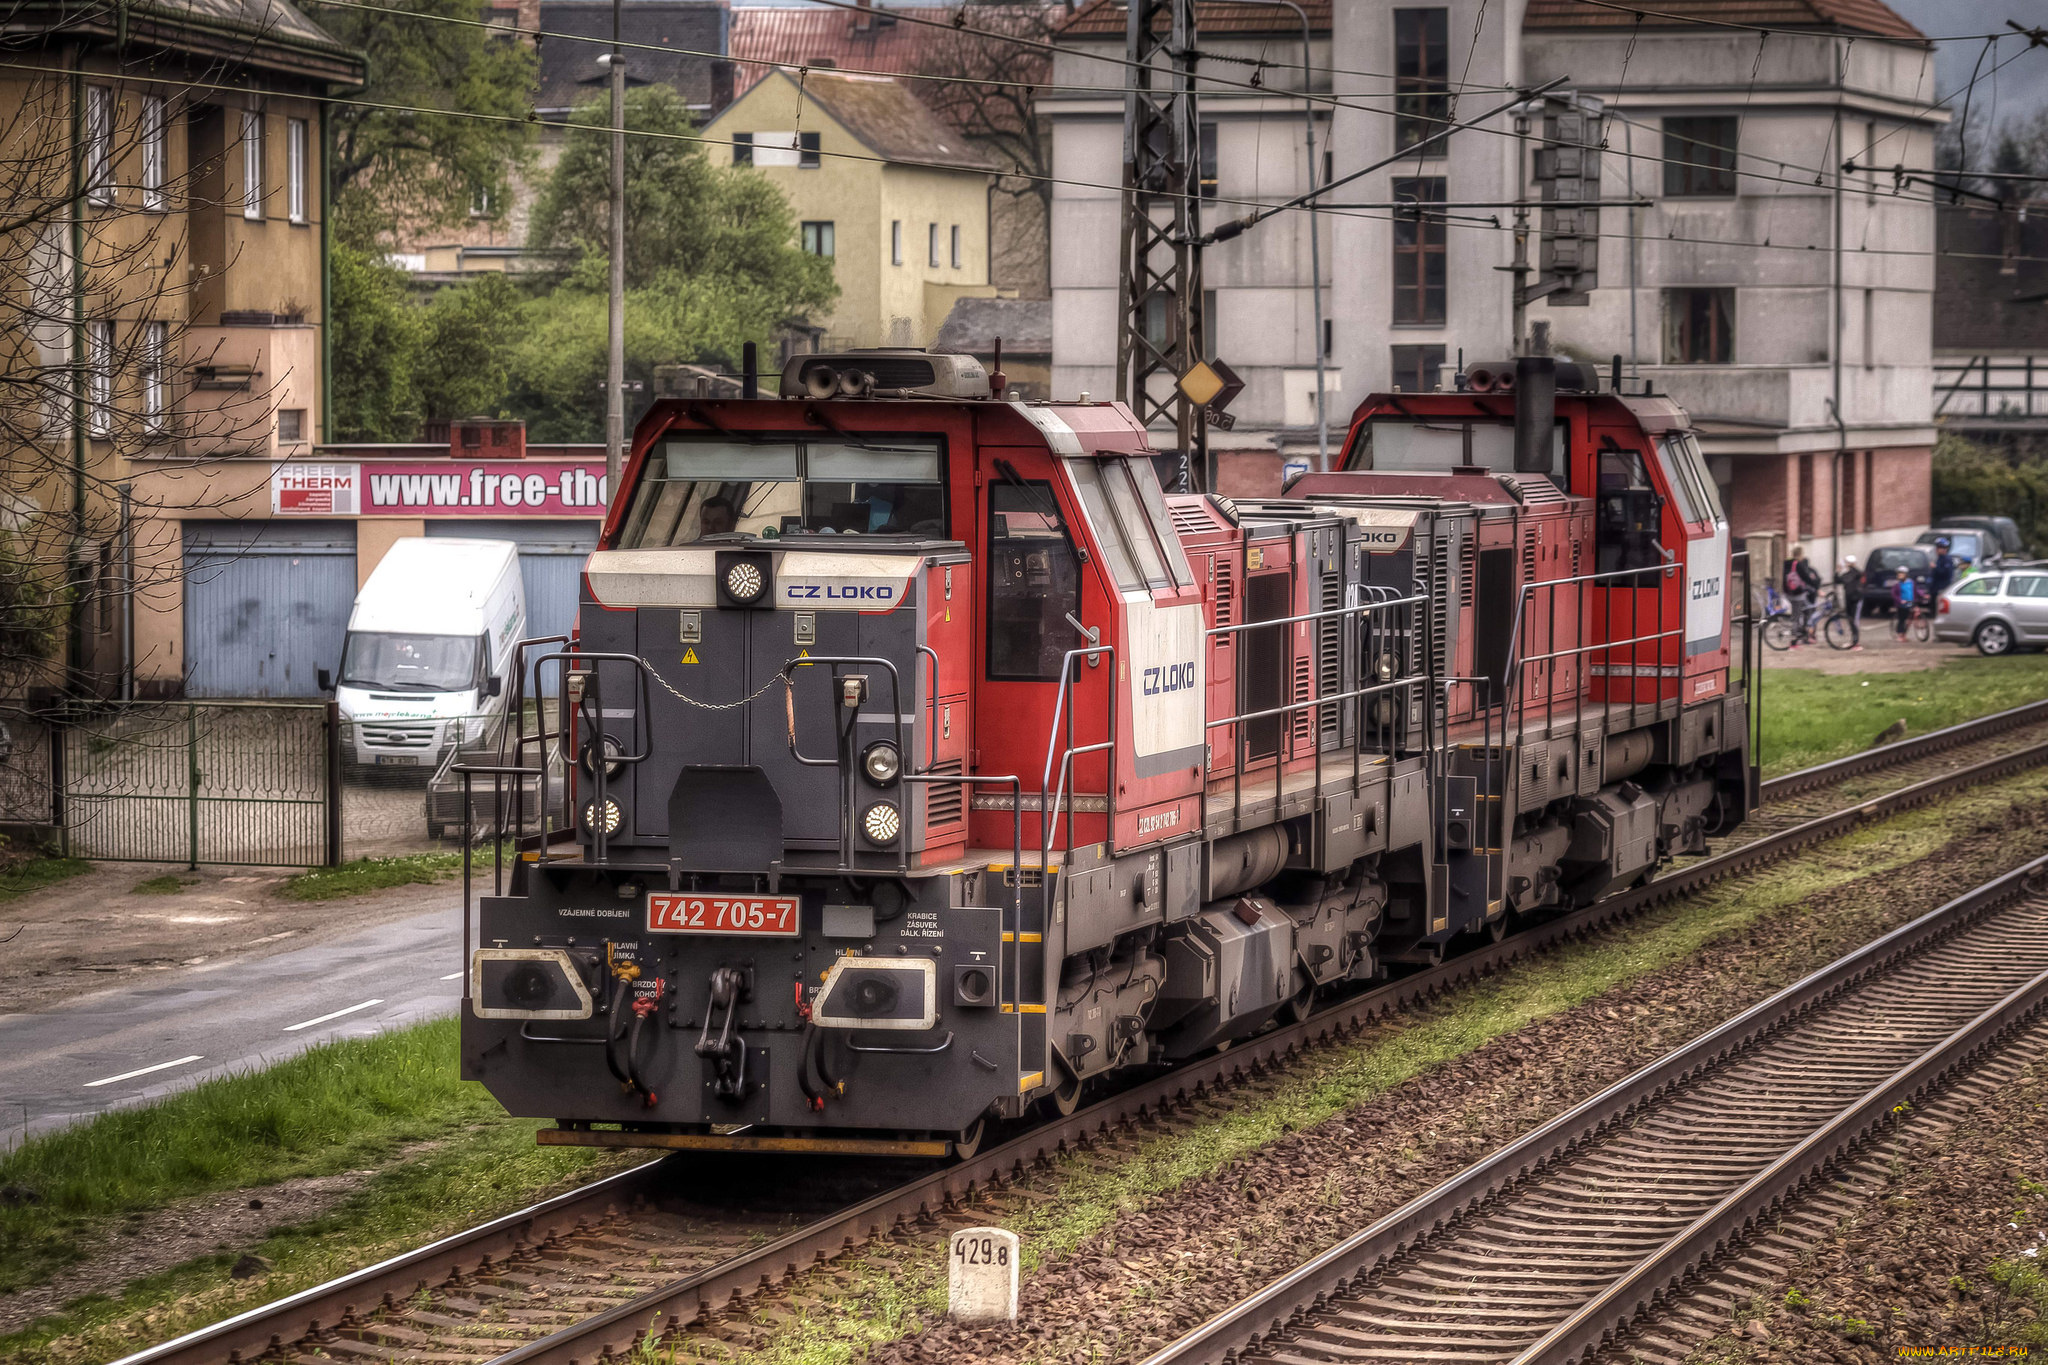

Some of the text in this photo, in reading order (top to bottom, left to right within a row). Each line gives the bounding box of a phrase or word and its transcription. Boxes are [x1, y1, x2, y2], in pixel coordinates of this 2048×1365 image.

[280, 477, 352, 488] THERM
[788, 586, 893, 599] CZ LOKO
[1144, 661, 1194, 696] CZ LOKO
[558, 907, 596, 917] VZÁJEMNÉ
[655, 901, 792, 929] 742 705-7
[907, 912, 937, 920] KRABICE
[906, 919, 938, 928] ZÁSUVEK
[900, 928, 920, 937] DÁLK.
[634, 990, 664, 998] KOHO
[955, 1238, 1007, 1266] 429.8
